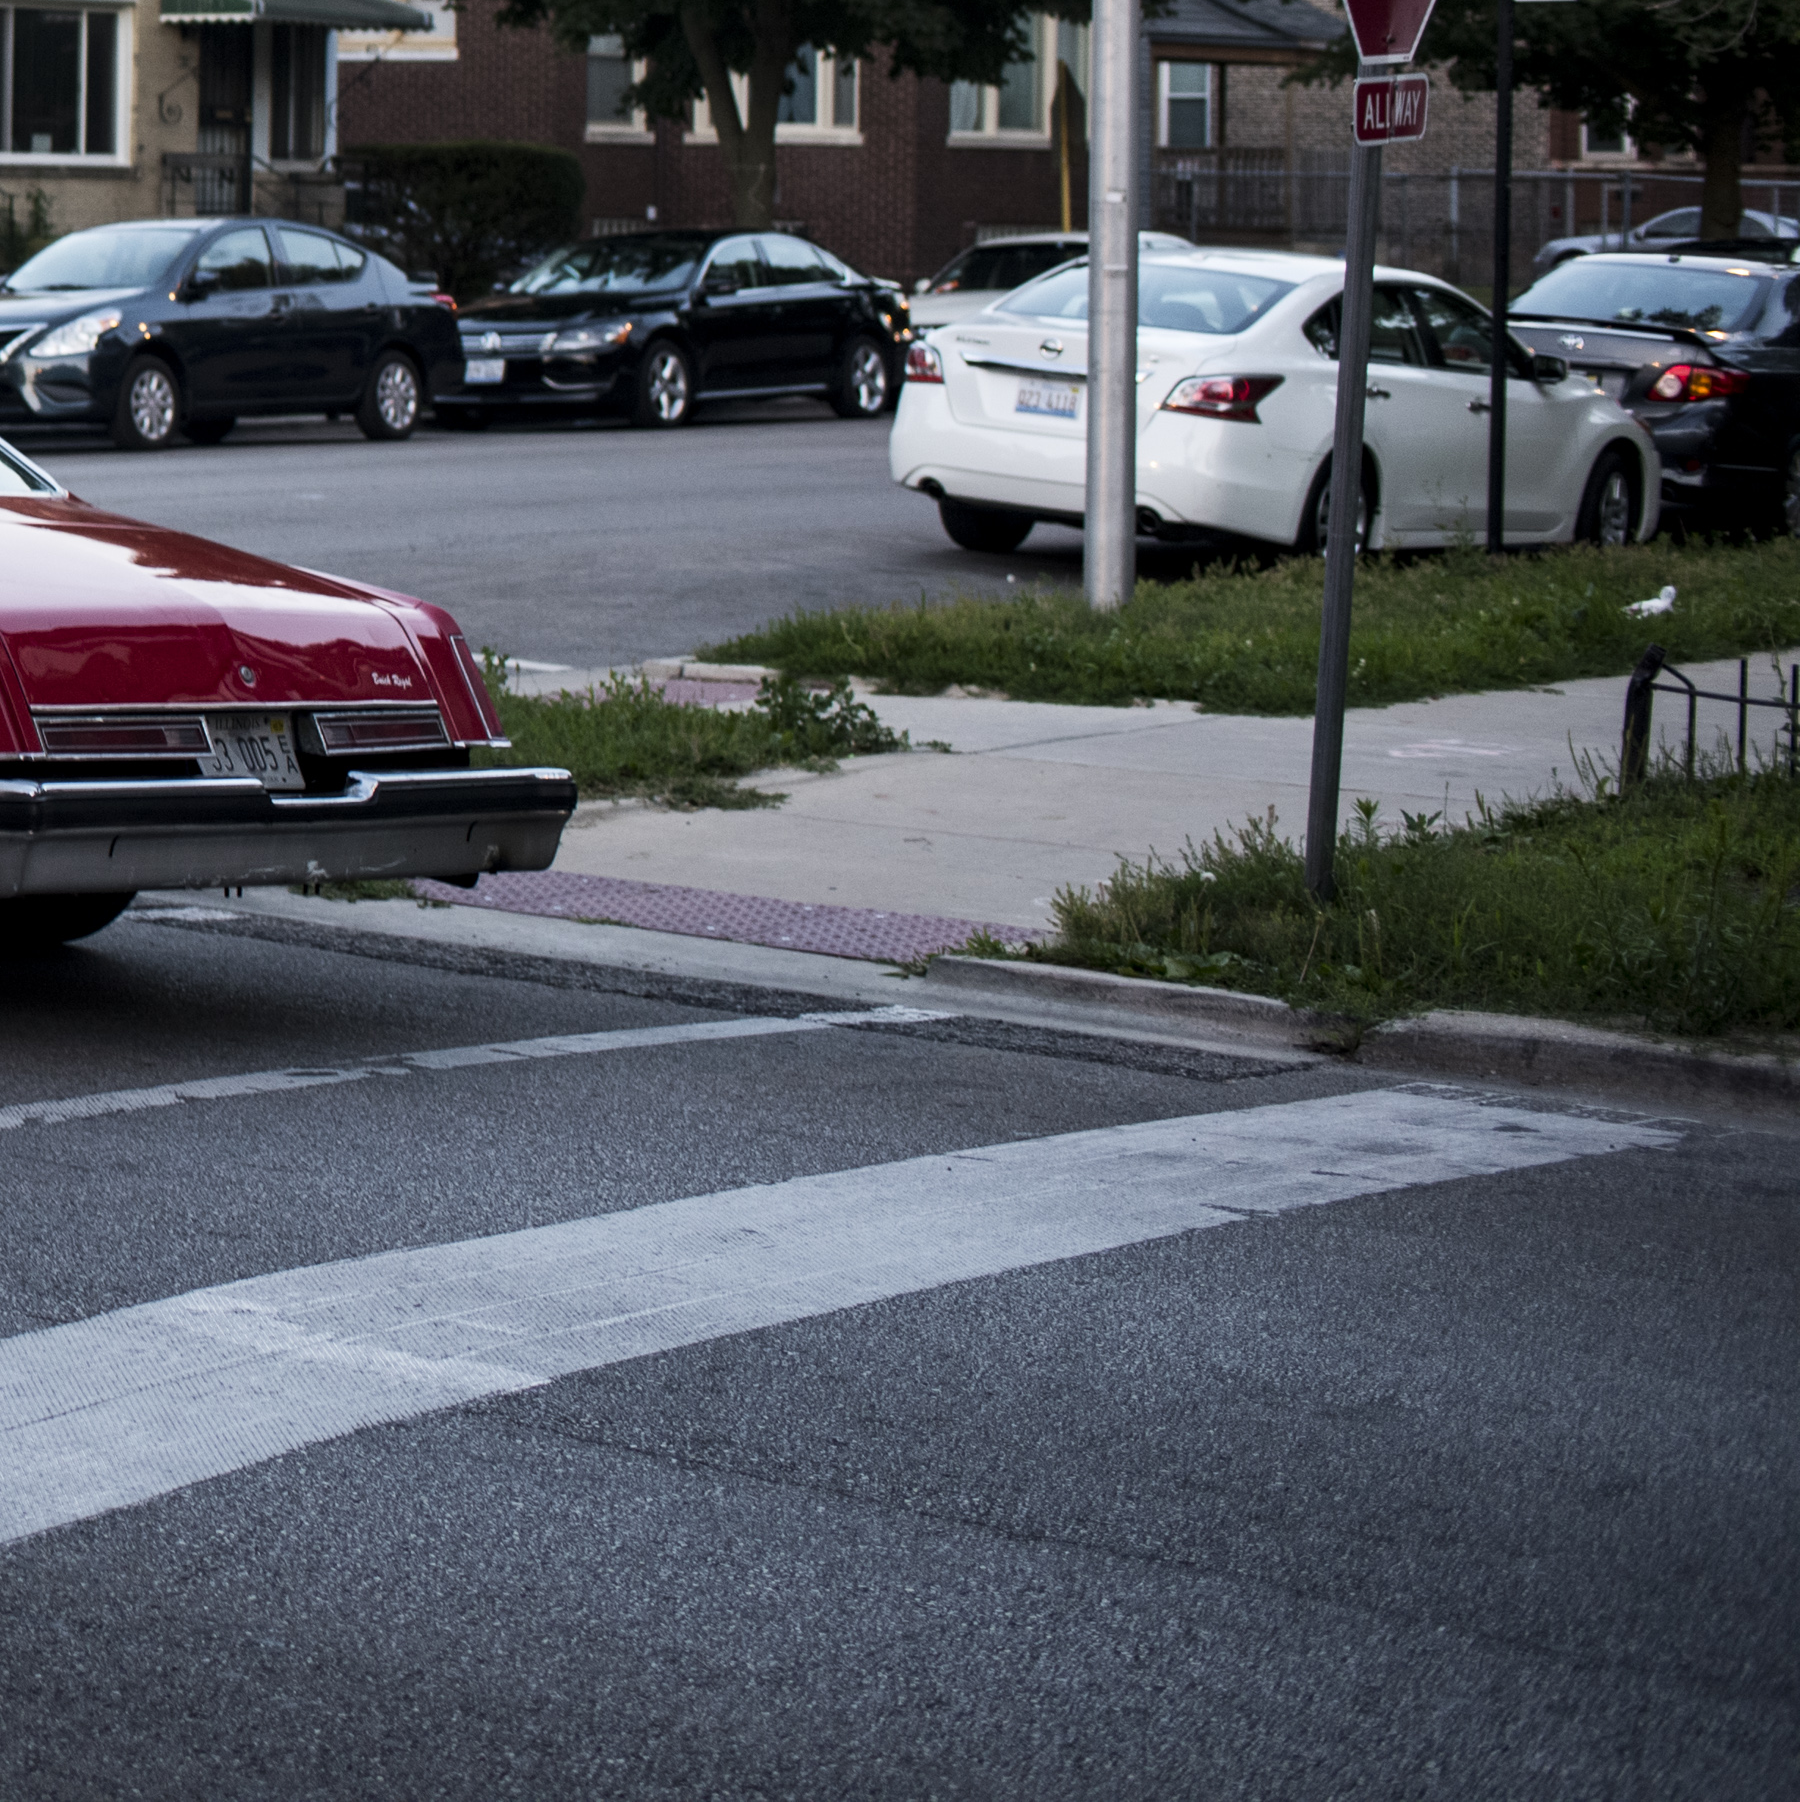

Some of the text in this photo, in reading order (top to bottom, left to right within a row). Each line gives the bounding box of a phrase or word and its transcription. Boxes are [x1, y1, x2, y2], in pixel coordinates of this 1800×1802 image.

[1363, 90, 1421, 130] ALL WAY
[237, 736, 279, 772] 005
